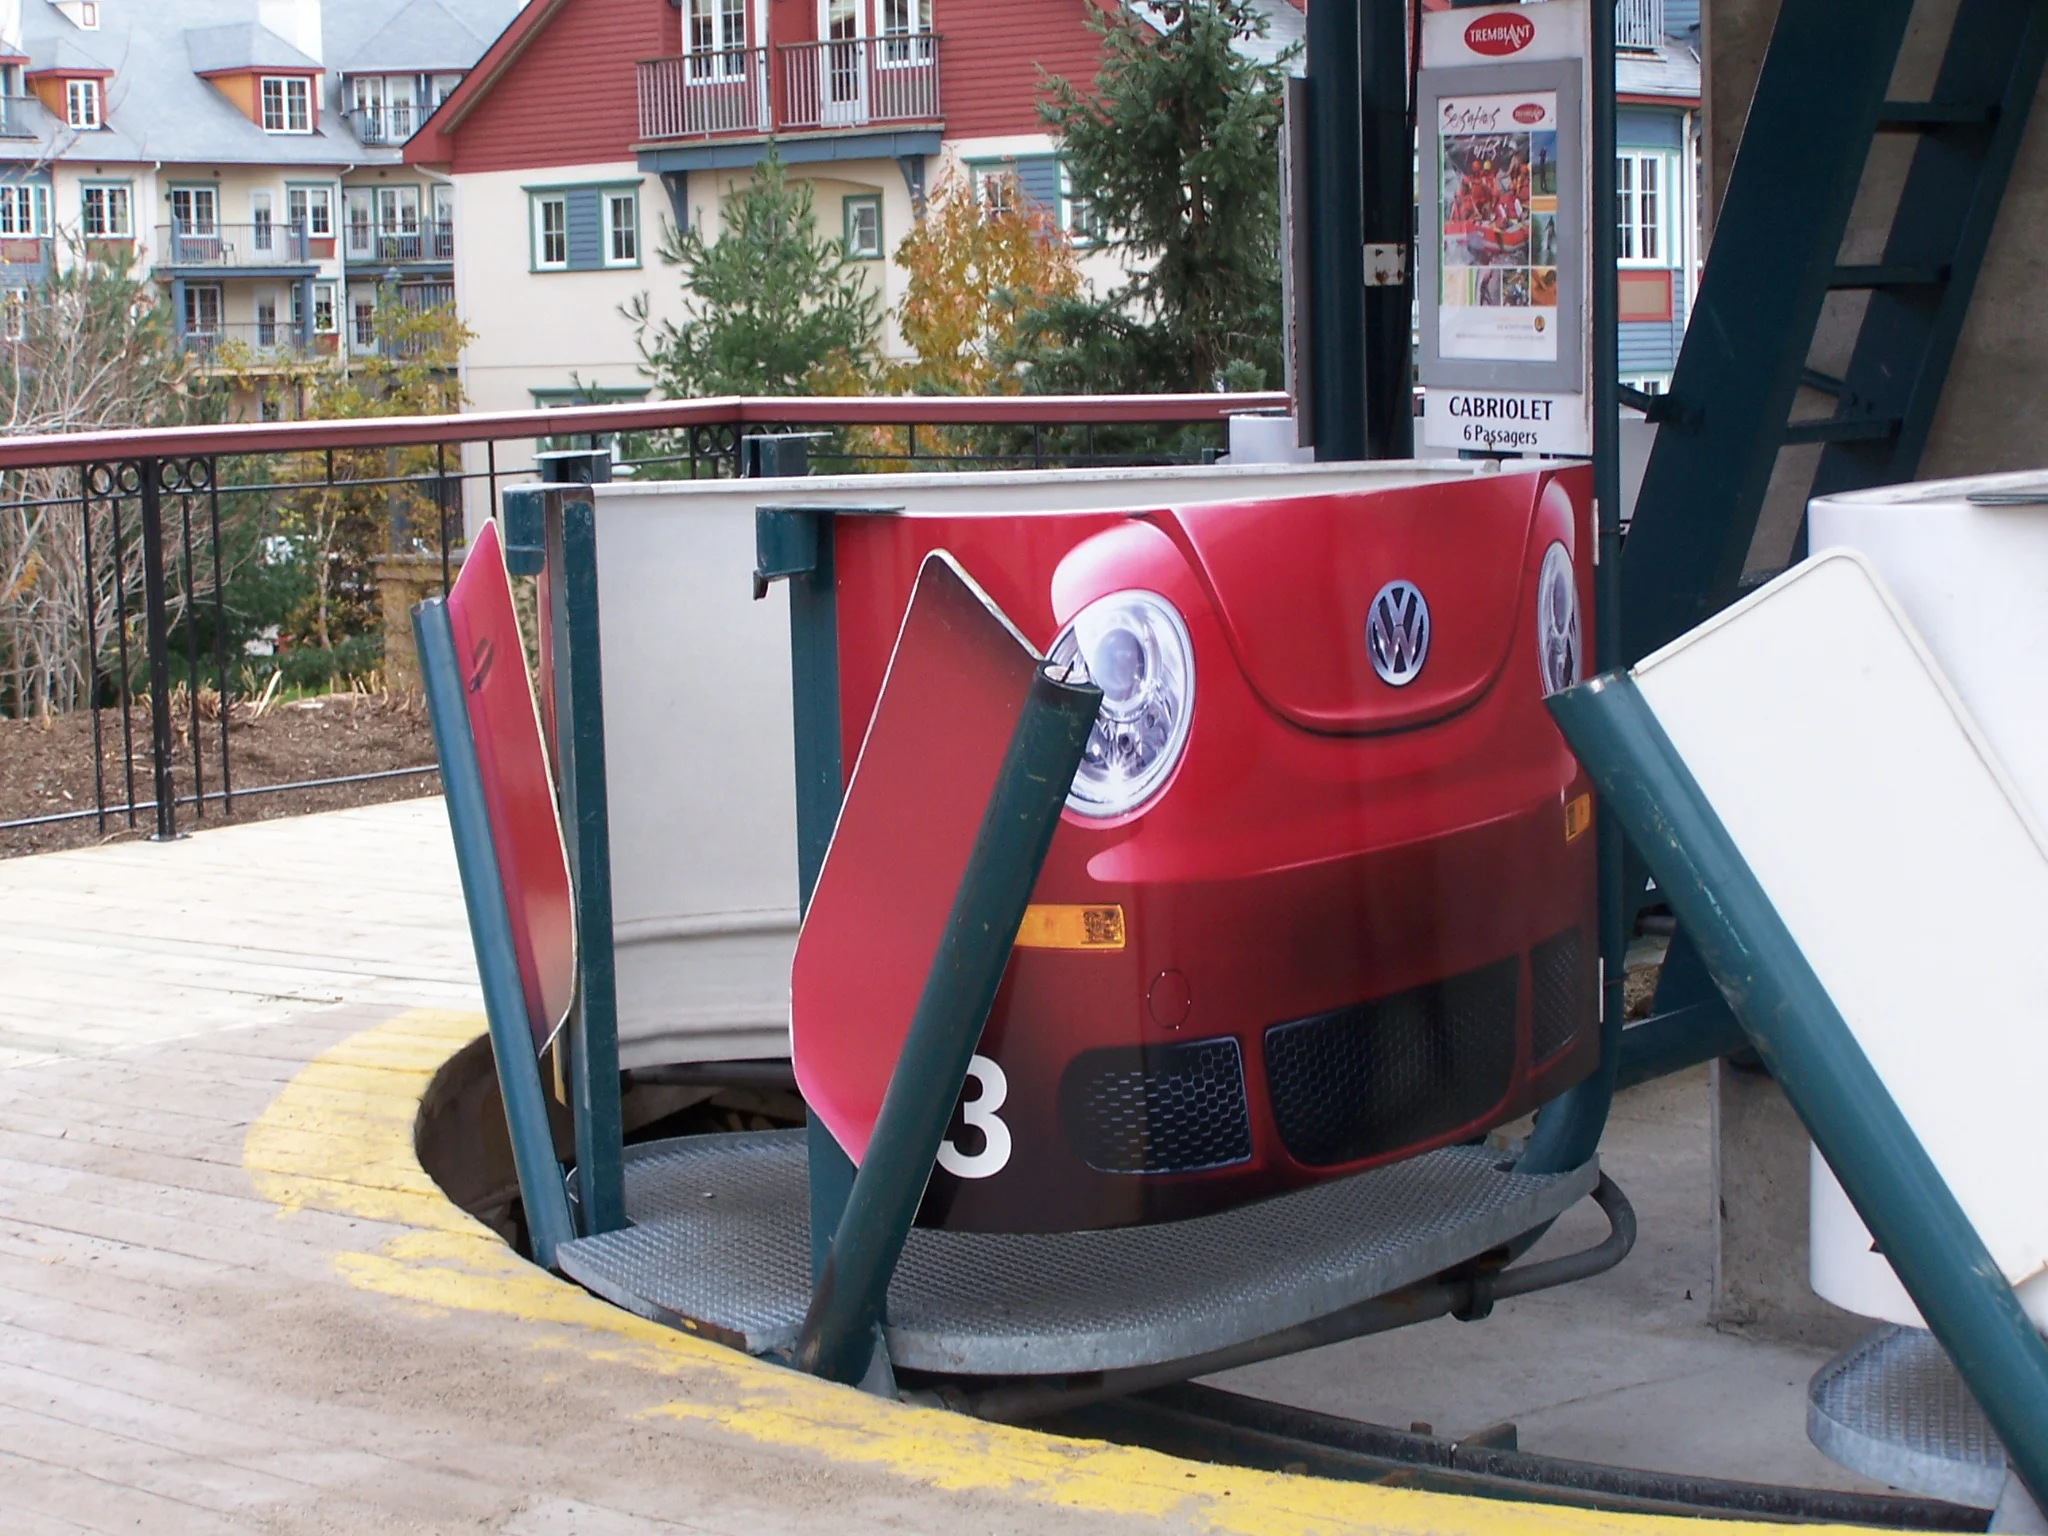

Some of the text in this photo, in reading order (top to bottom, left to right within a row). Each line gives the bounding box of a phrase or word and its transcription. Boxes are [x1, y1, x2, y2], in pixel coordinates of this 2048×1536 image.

[1470, 24, 1531, 48] TREMBLANT
[1449, 396, 1553, 420] CABRIOLET
[1463, 425, 1538, 447] 6 Passagers
[936, 1054, 1012, 1179] 3
